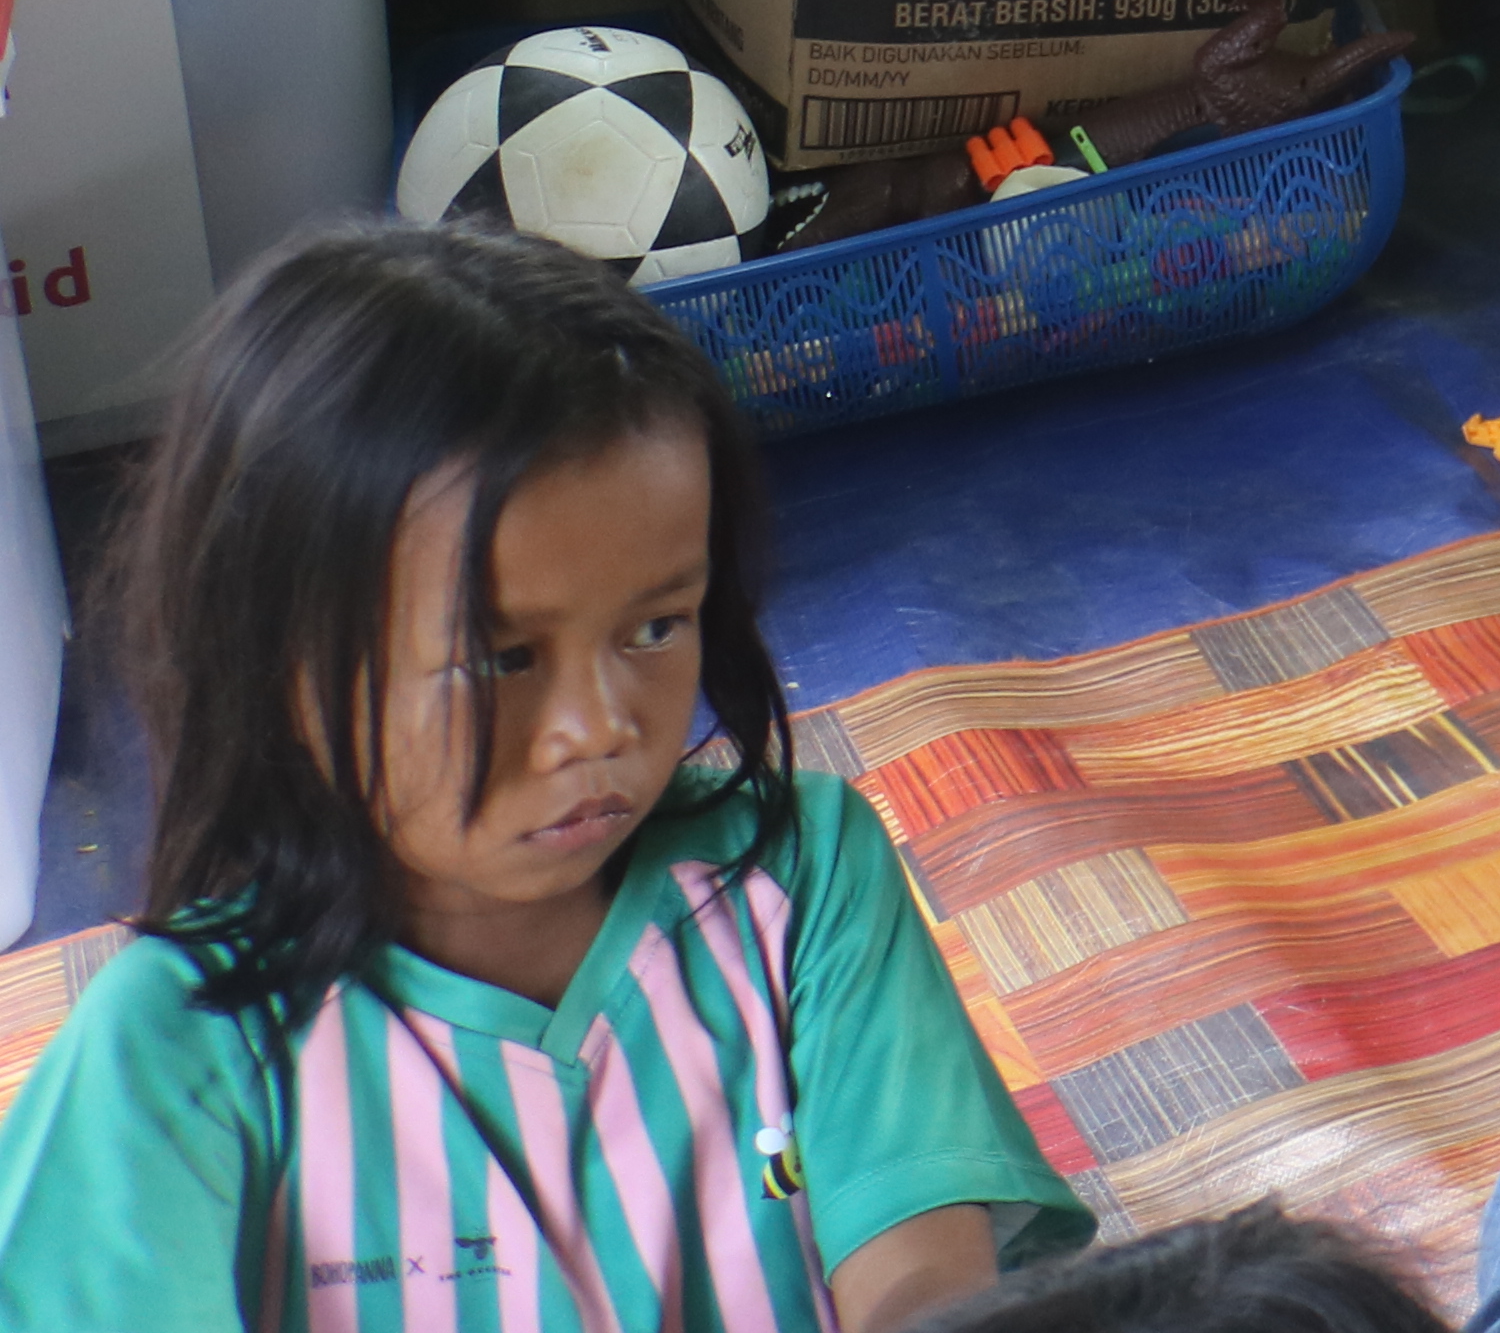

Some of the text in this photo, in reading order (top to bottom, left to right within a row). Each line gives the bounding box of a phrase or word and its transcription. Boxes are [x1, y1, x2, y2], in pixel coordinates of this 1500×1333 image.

[894, 1, 987, 29] BERAT
[809, 40, 1085, 64] BAIK DIGUNAKAN SEBELUM:
[808, 67, 909, 89] DD/MM/YY
